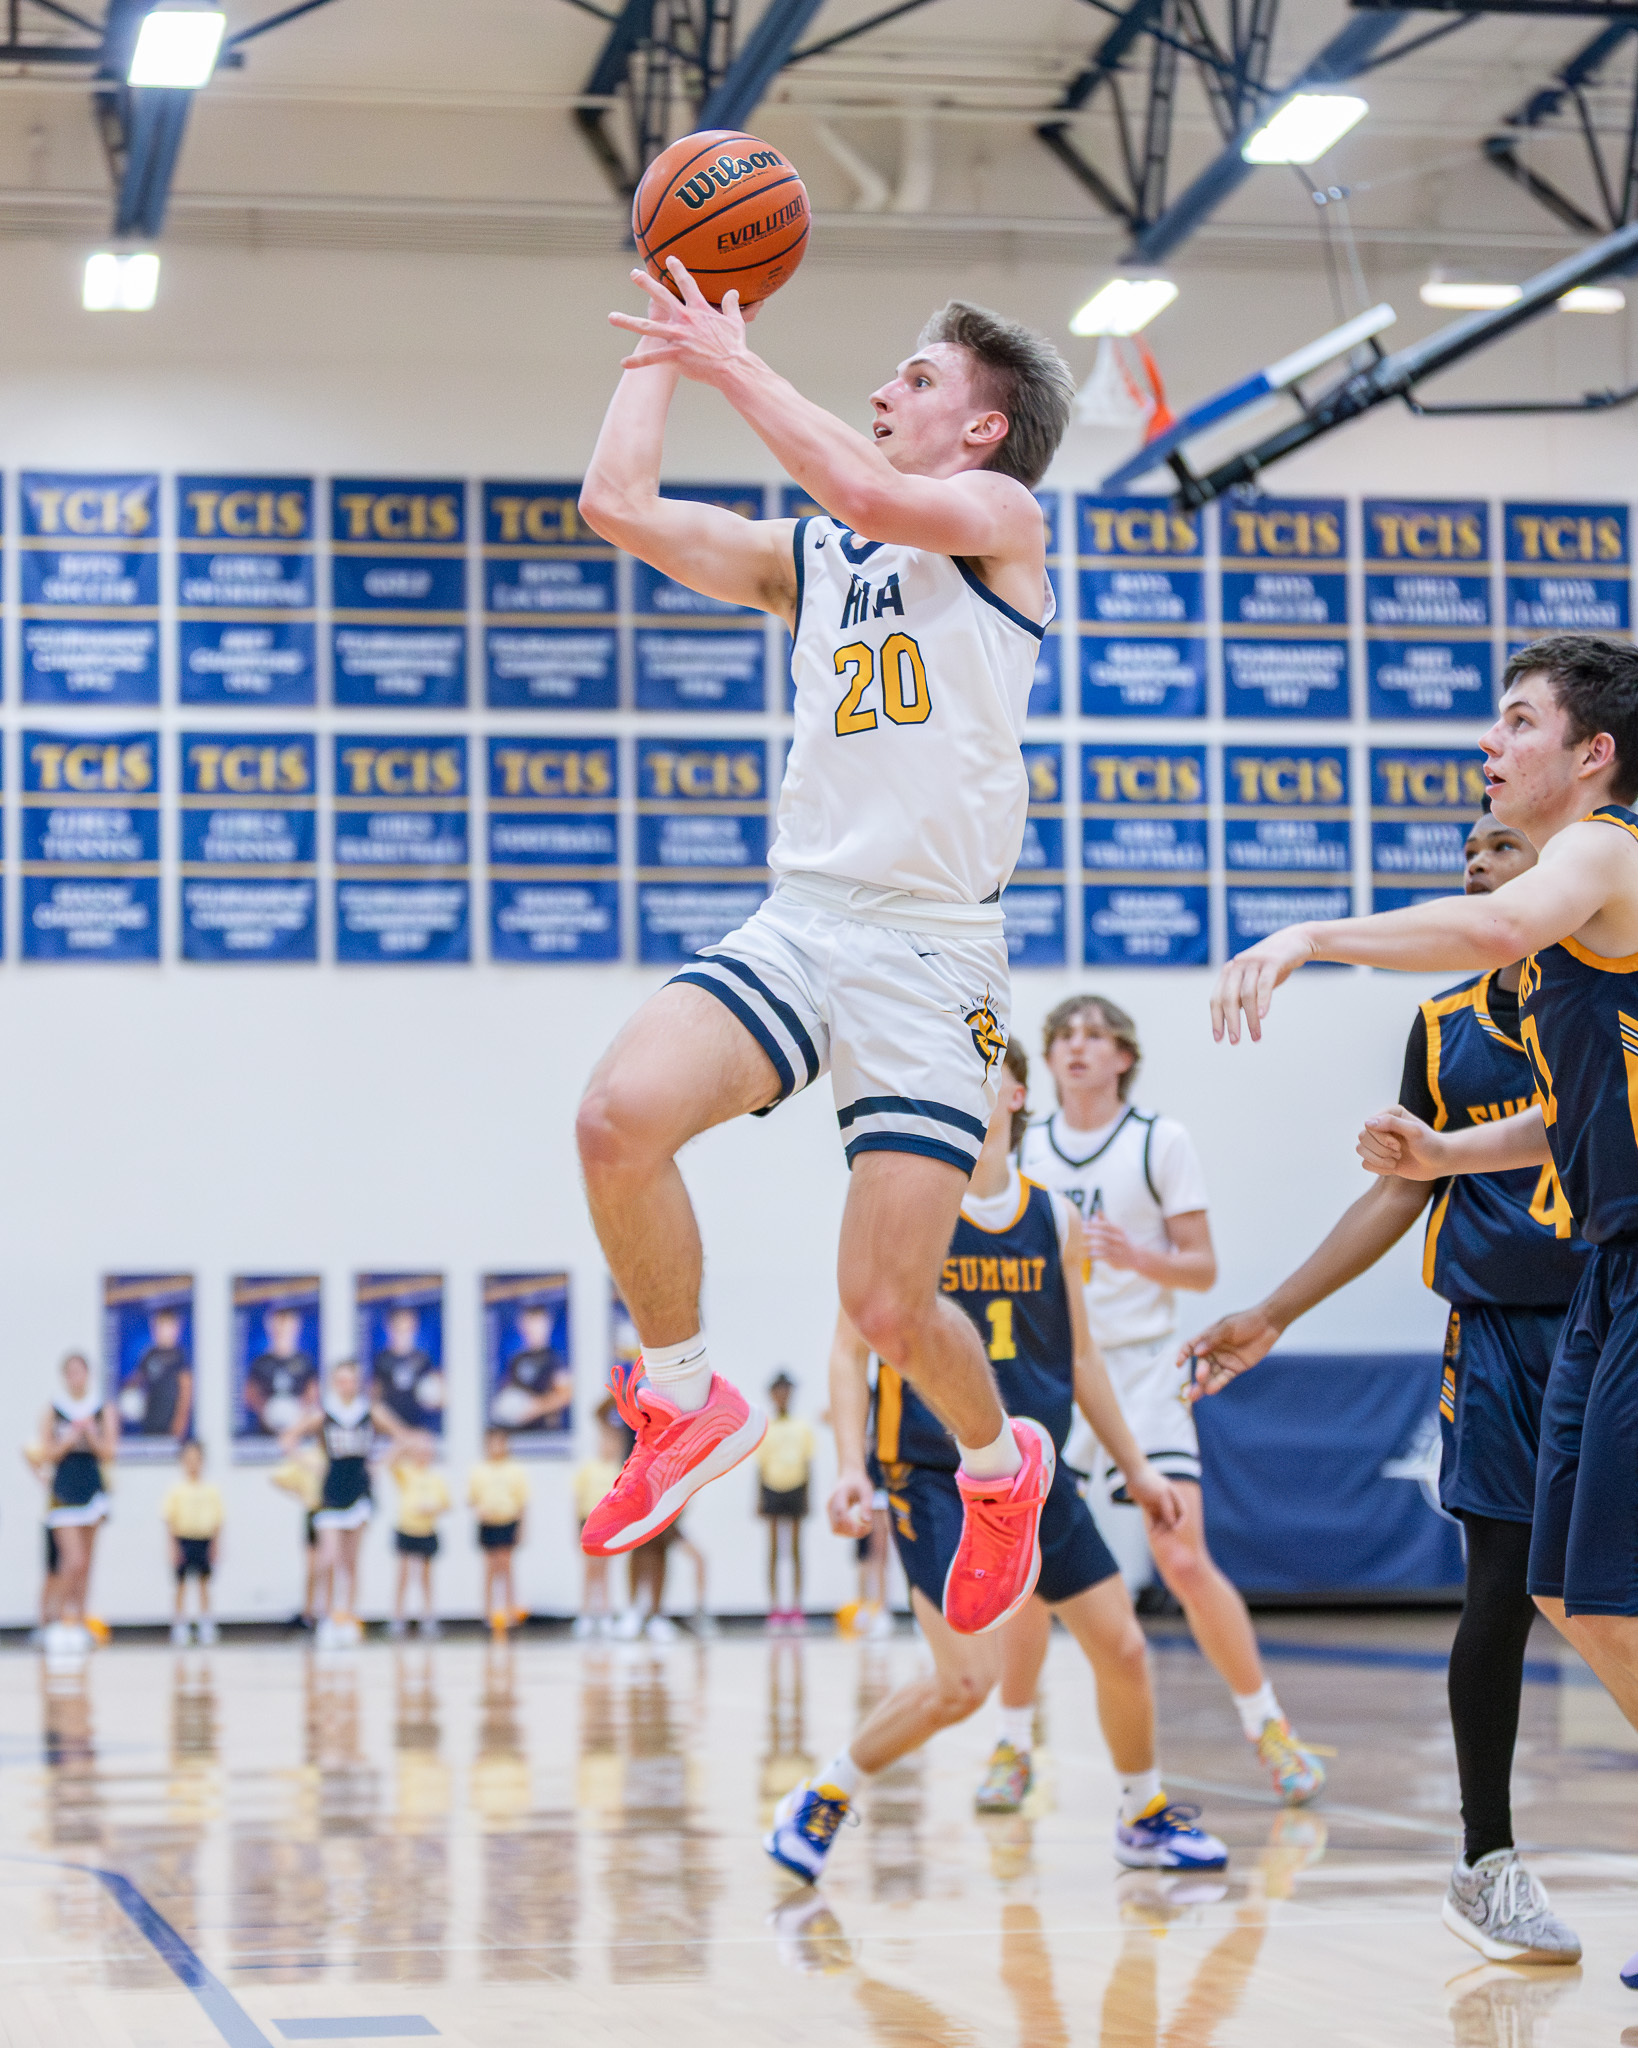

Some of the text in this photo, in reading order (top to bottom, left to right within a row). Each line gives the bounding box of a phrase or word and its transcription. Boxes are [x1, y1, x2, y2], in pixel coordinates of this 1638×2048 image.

[674, 151, 785, 210] Wilson
[717, 194, 805, 251] EVOLUTION
[32, 488, 149, 534] TCIS
[188, 490, 306, 536] TCIS
[341, 493, 457, 539] TCIS
[493, 495, 588, 541] TCI
[1085, 507, 1198, 552] TCIS
[1231, 510, 1339, 554] TCIS
[1374, 513, 1481, 558] TCIS
[1515, 516, 1622, 560] TCIS
[834, 632, 932, 737] 20
[32, 743, 152, 790] TCIS
[188, 745, 308, 793] TCIS
[343, 747, 461, 794] TCIS
[496, 750, 611, 795] TCIS
[645, 751, 759, 796] TCIS
[1090, 756, 1200, 800] TCIS
[1234, 758, 1342, 802] TCIS
[1528, 1160, 1573, 1239] 4
[942, 1256, 1046, 1292] SUMMIT
[986, 1298, 1016, 1360] 1
